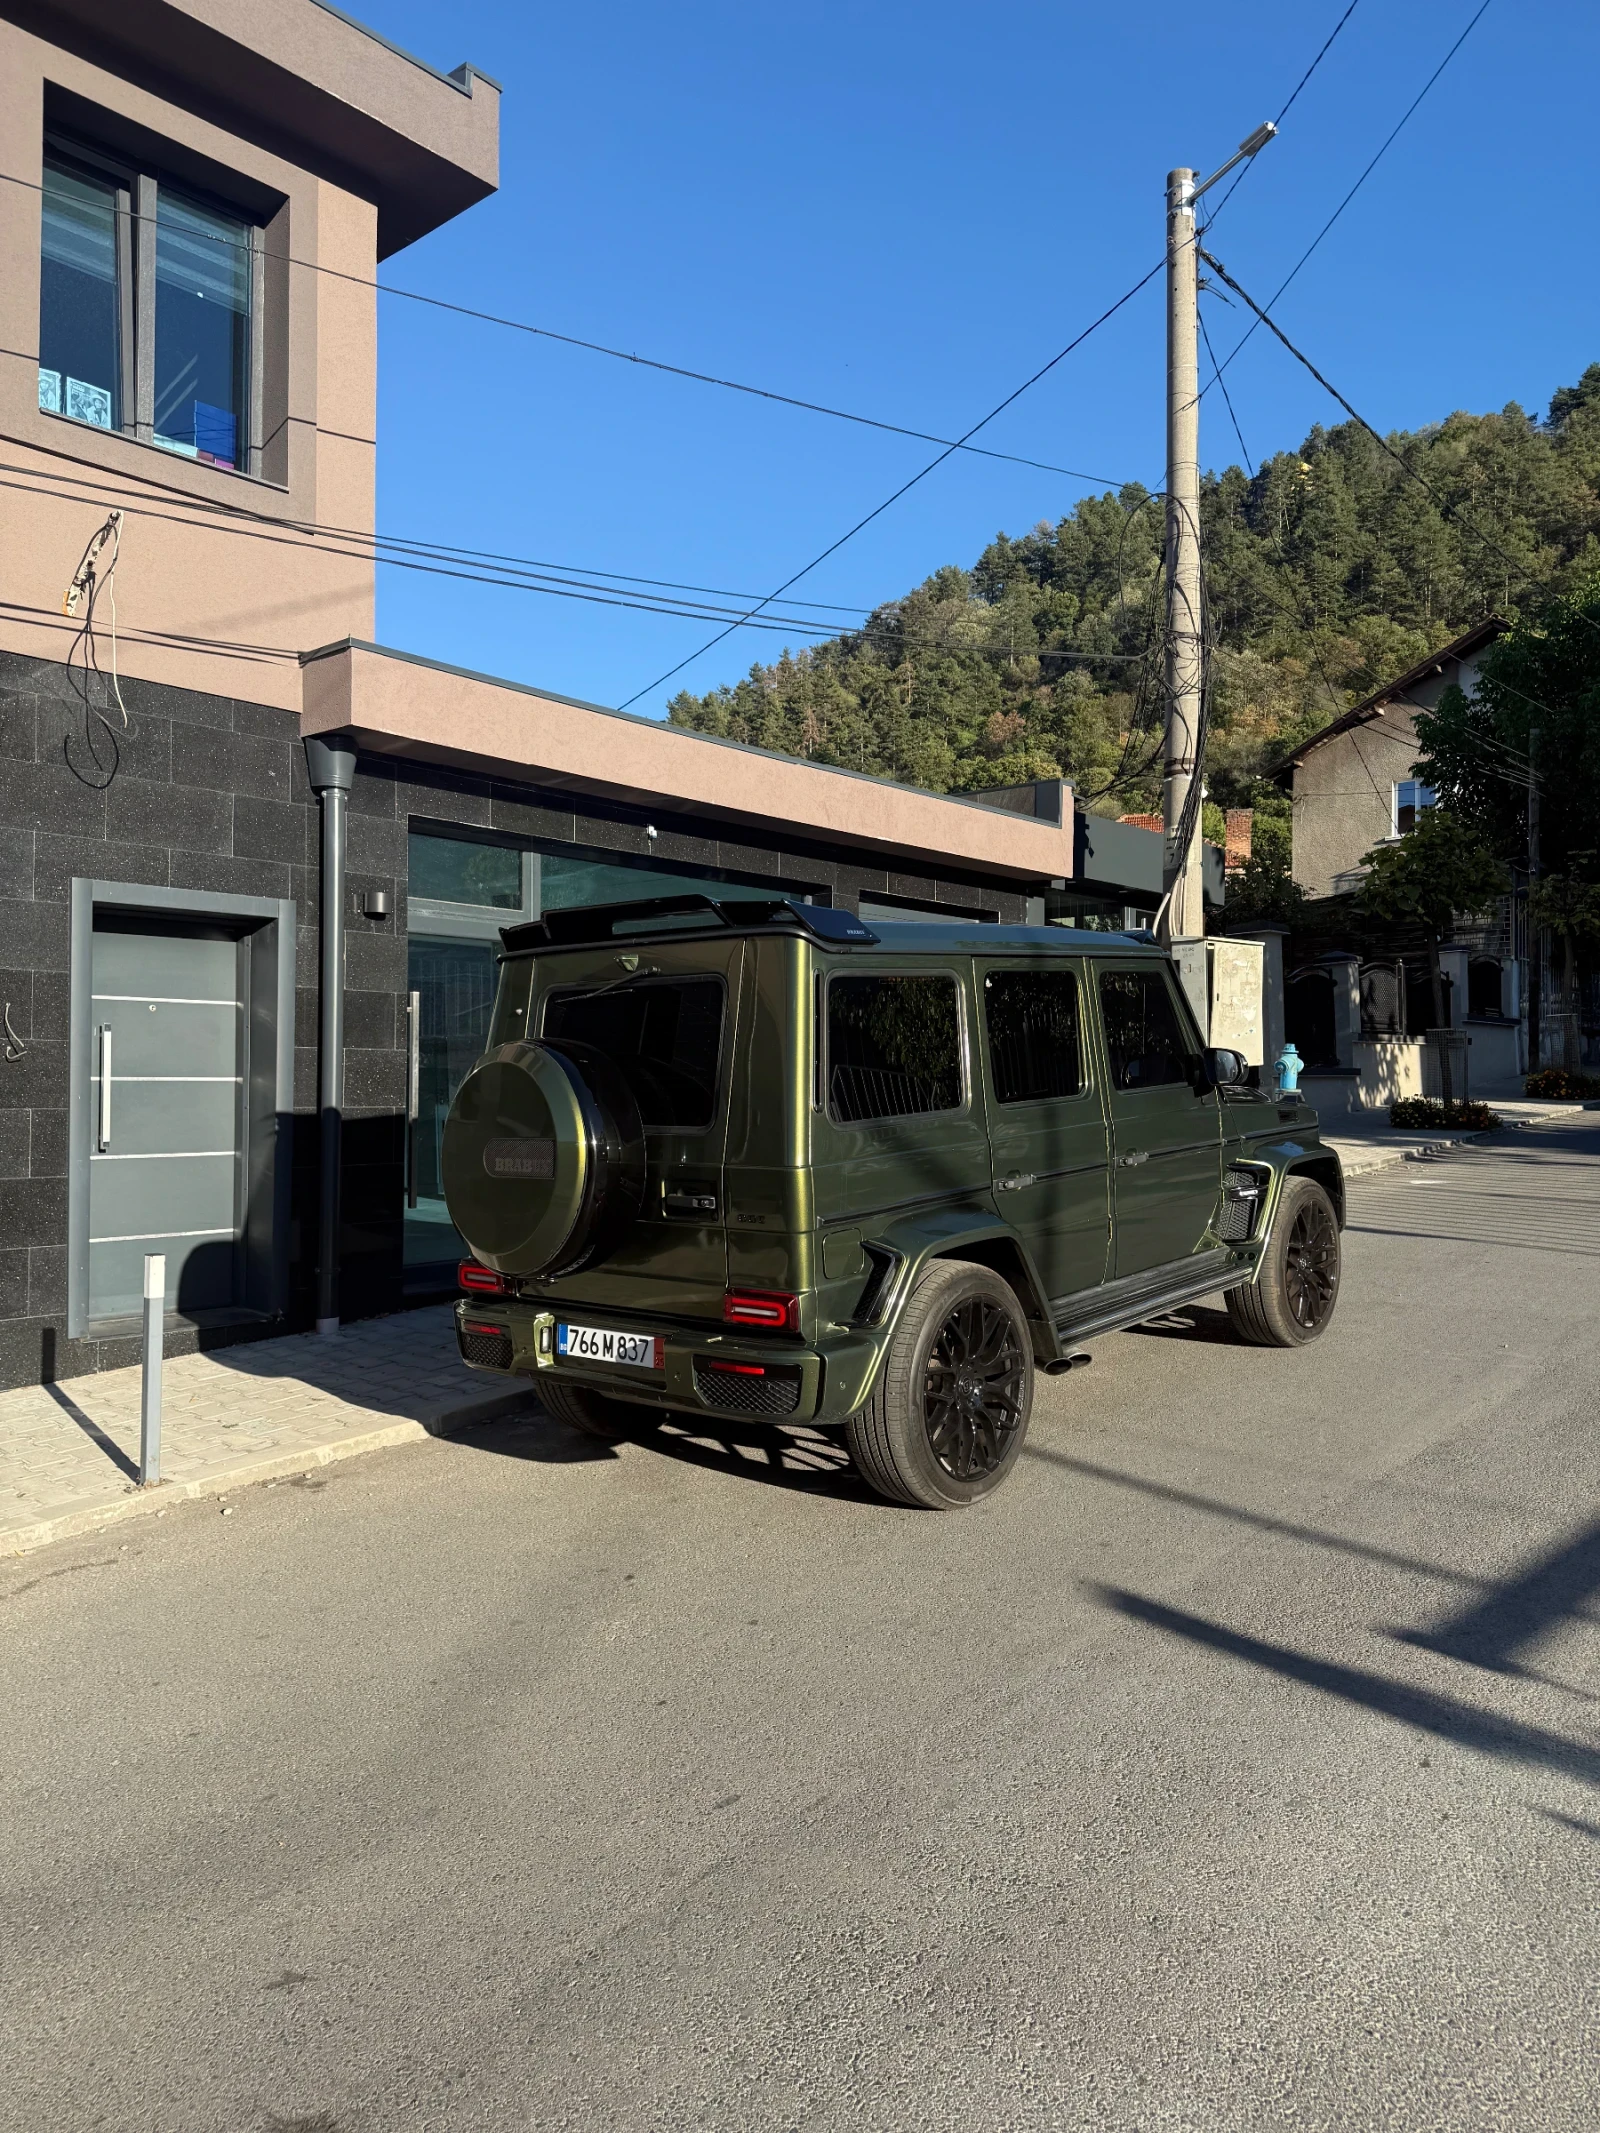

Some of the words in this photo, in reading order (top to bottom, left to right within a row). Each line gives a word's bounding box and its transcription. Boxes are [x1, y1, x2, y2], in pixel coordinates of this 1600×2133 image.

[569, 1329, 599, 1355] 766
[602, 1333, 614, 1358] M
[617, 1336, 649, 1363] 837
